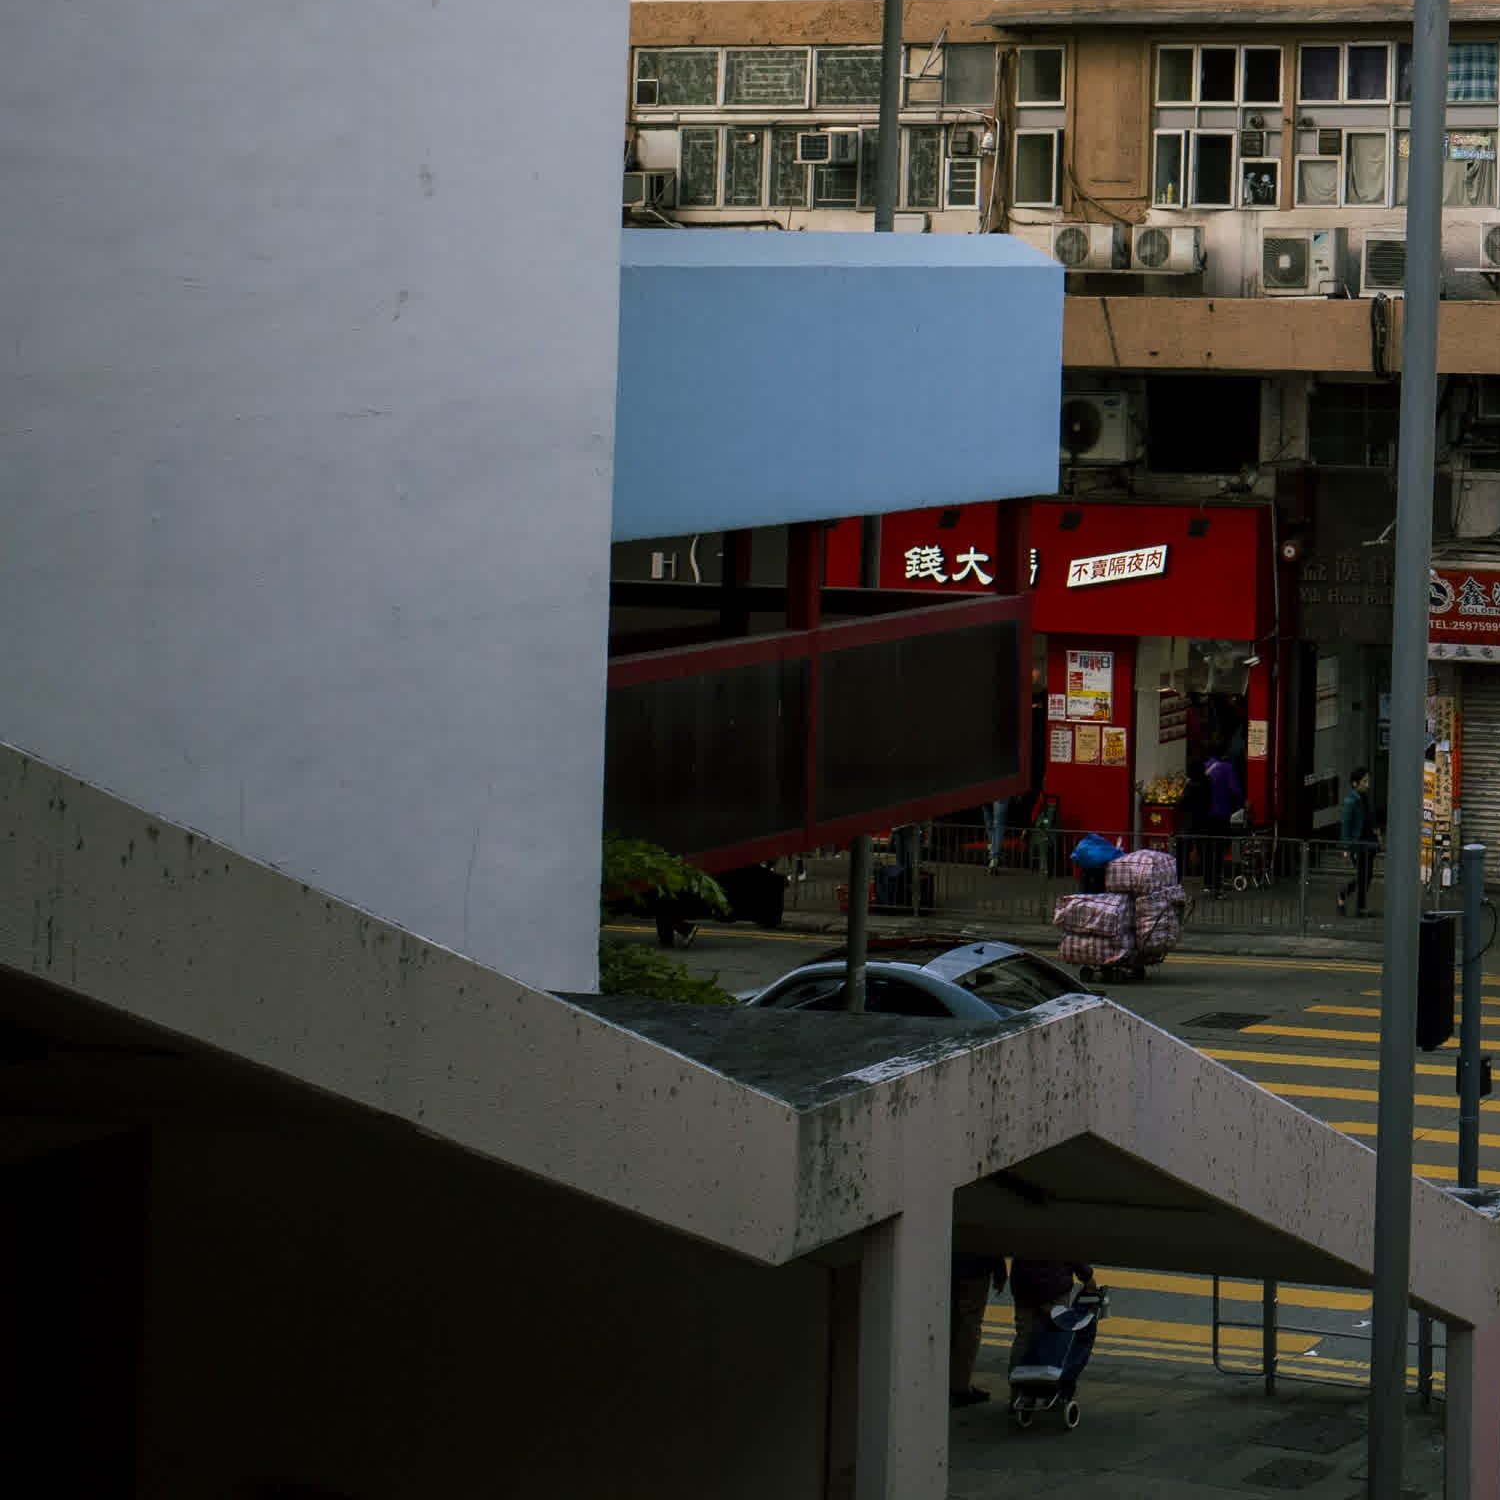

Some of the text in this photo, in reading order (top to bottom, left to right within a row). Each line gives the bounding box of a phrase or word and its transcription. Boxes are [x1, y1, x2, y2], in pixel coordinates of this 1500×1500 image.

[1071, 550, 1163, 582] 不賣隔夜肉
